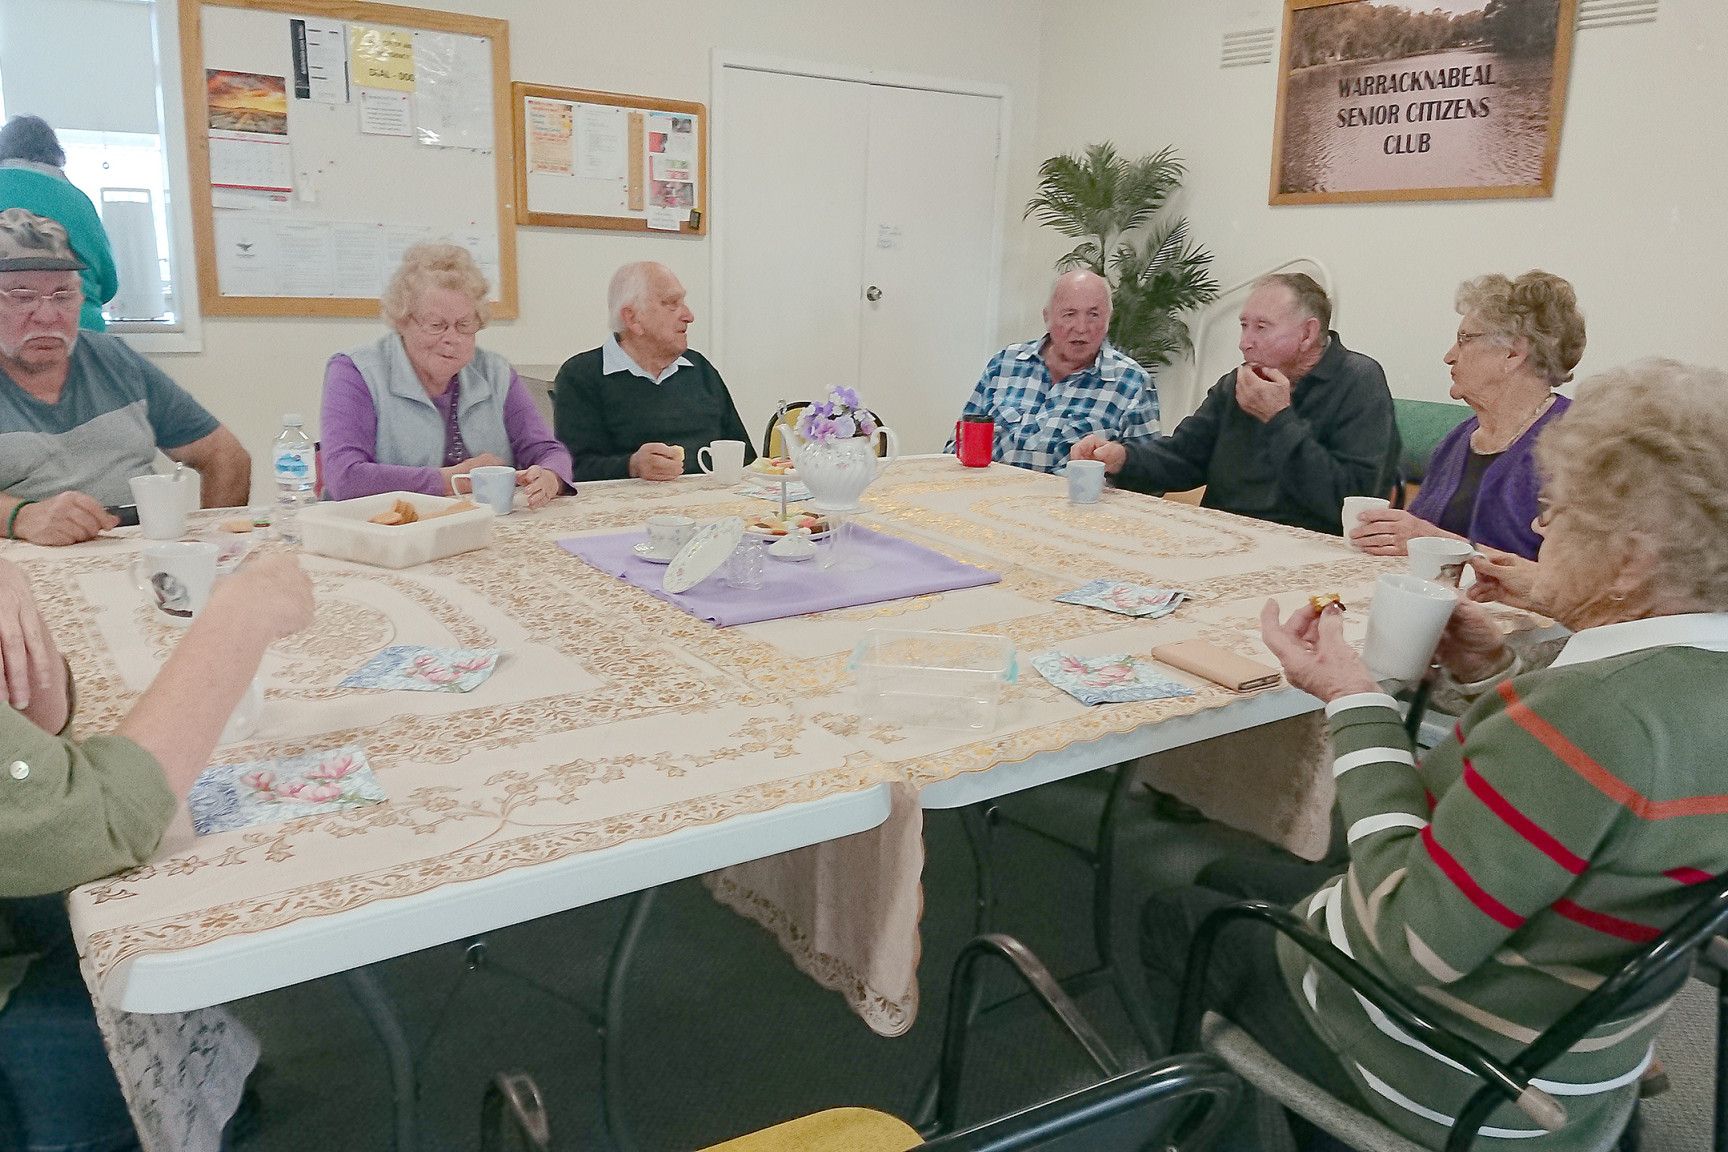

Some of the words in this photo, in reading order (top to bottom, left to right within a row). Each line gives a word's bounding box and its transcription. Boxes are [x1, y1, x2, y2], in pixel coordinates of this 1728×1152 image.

[1338, 64, 1496, 97] WARRACKNABEAL
[1336, 103, 1400, 128] SENIOR
[1405, 97, 1490, 123] CITIZENS
[1383, 133, 1432, 155] CLUB
